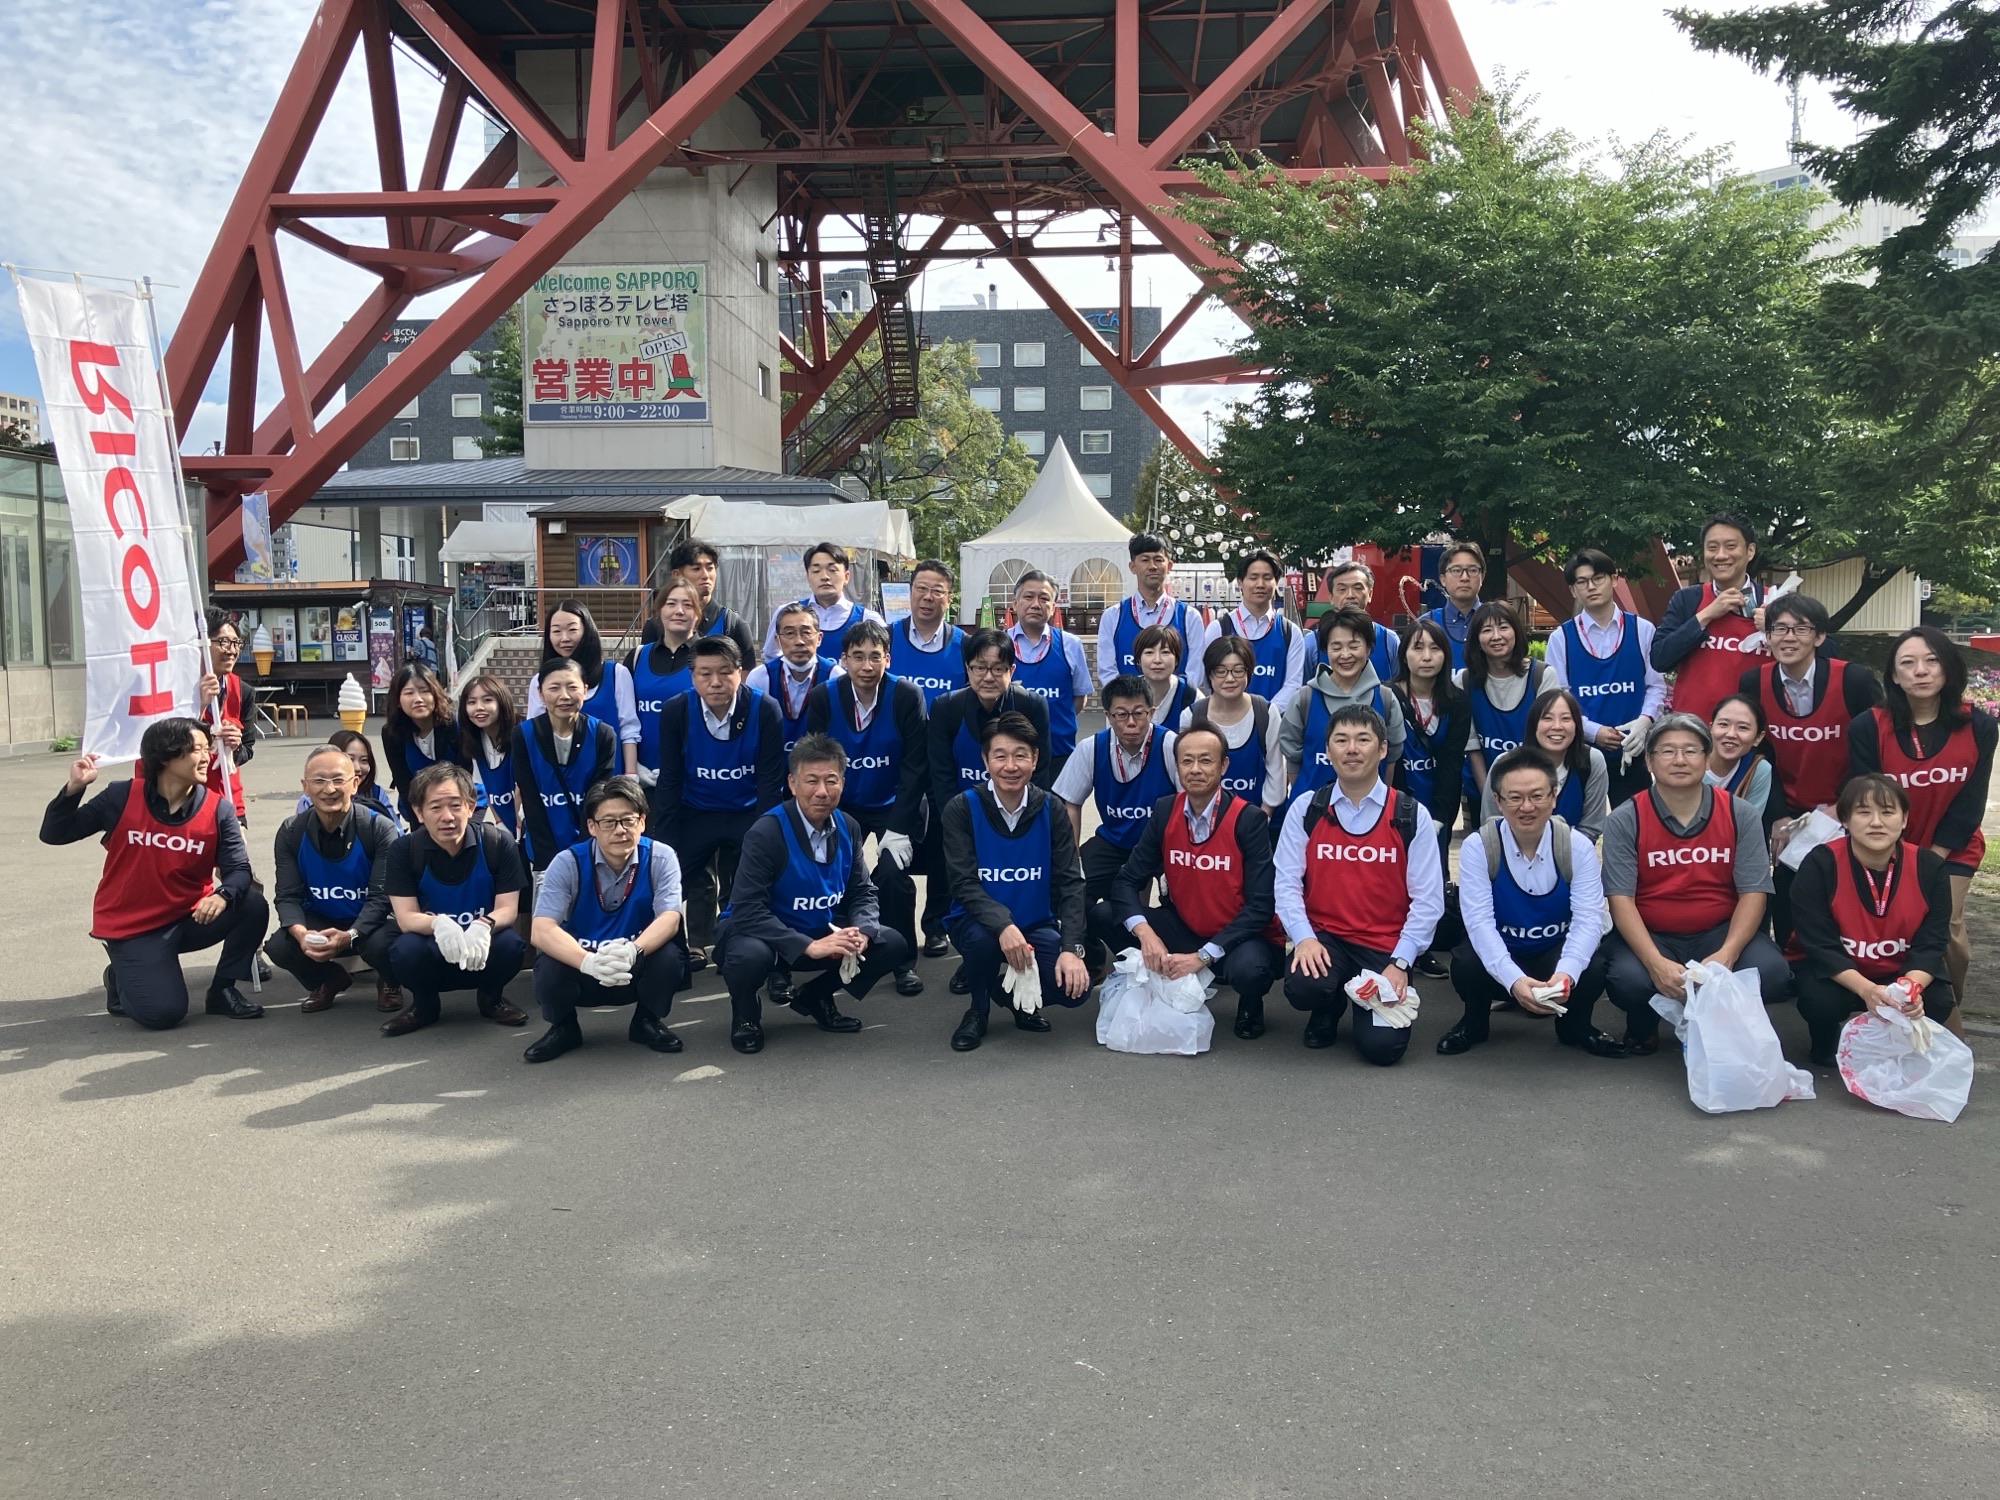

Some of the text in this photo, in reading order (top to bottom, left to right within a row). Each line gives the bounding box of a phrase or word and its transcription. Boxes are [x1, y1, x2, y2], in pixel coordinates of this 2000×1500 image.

[533, 271, 698, 293] Welcome SAPPORO
[544, 294, 689, 313] さっぽろテレビ塔
[559, 315, 673, 329] Sapporo TV Tower
[644, 335, 682, 356] OPEN
[532, 357, 655, 401] 営業中
[70, 340, 174, 716] RICOH
[336, 633, 359, 642] CLASSIC
[1579, 682, 1635, 697] RICOH
[638, 700, 662, 712] RIC
[1768, 724, 1840, 741] RICOH
[846, 756, 889, 769] COH
[697, 764, 755, 780] RICOH
[961, 768, 990, 781] RIC
[1221, 777, 1256, 790] COH
[489, 790, 515, 806] ICO
[540, 791, 585, 807] RICH
[128, 830, 205, 855] RICOH
[1317, 844, 1397, 863] RICOH
[1648, 847, 1730, 867] RICOH
[978, 867, 1042, 882] RICOH
[309, 886, 369, 901] RICOH
[793, 891, 844, 910] RICOH
